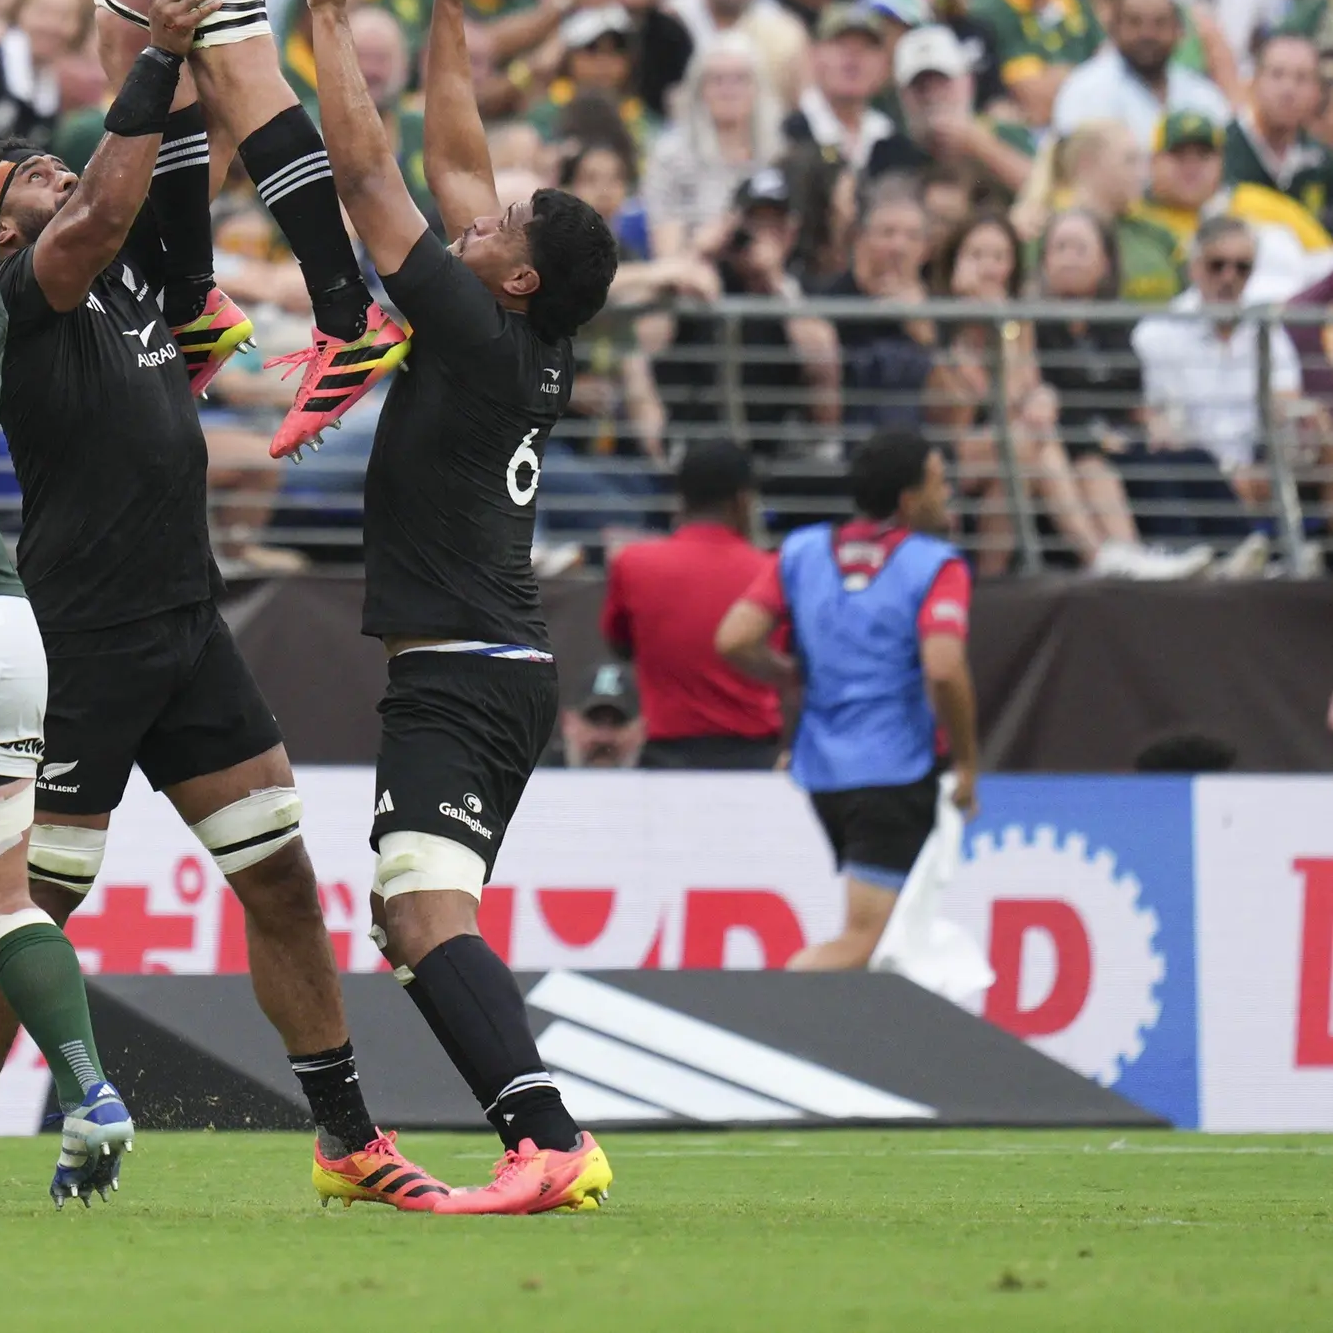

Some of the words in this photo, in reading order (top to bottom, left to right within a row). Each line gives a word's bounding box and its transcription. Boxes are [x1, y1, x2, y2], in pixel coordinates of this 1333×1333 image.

[137, 343, 178, 368] ALRAD
[506, 428, 541, 507] 6
[35, 781, 48, 790] ALL
[47, 783, 78, 794] BLACKS
[438, 802, 493, 840] Gallagher
